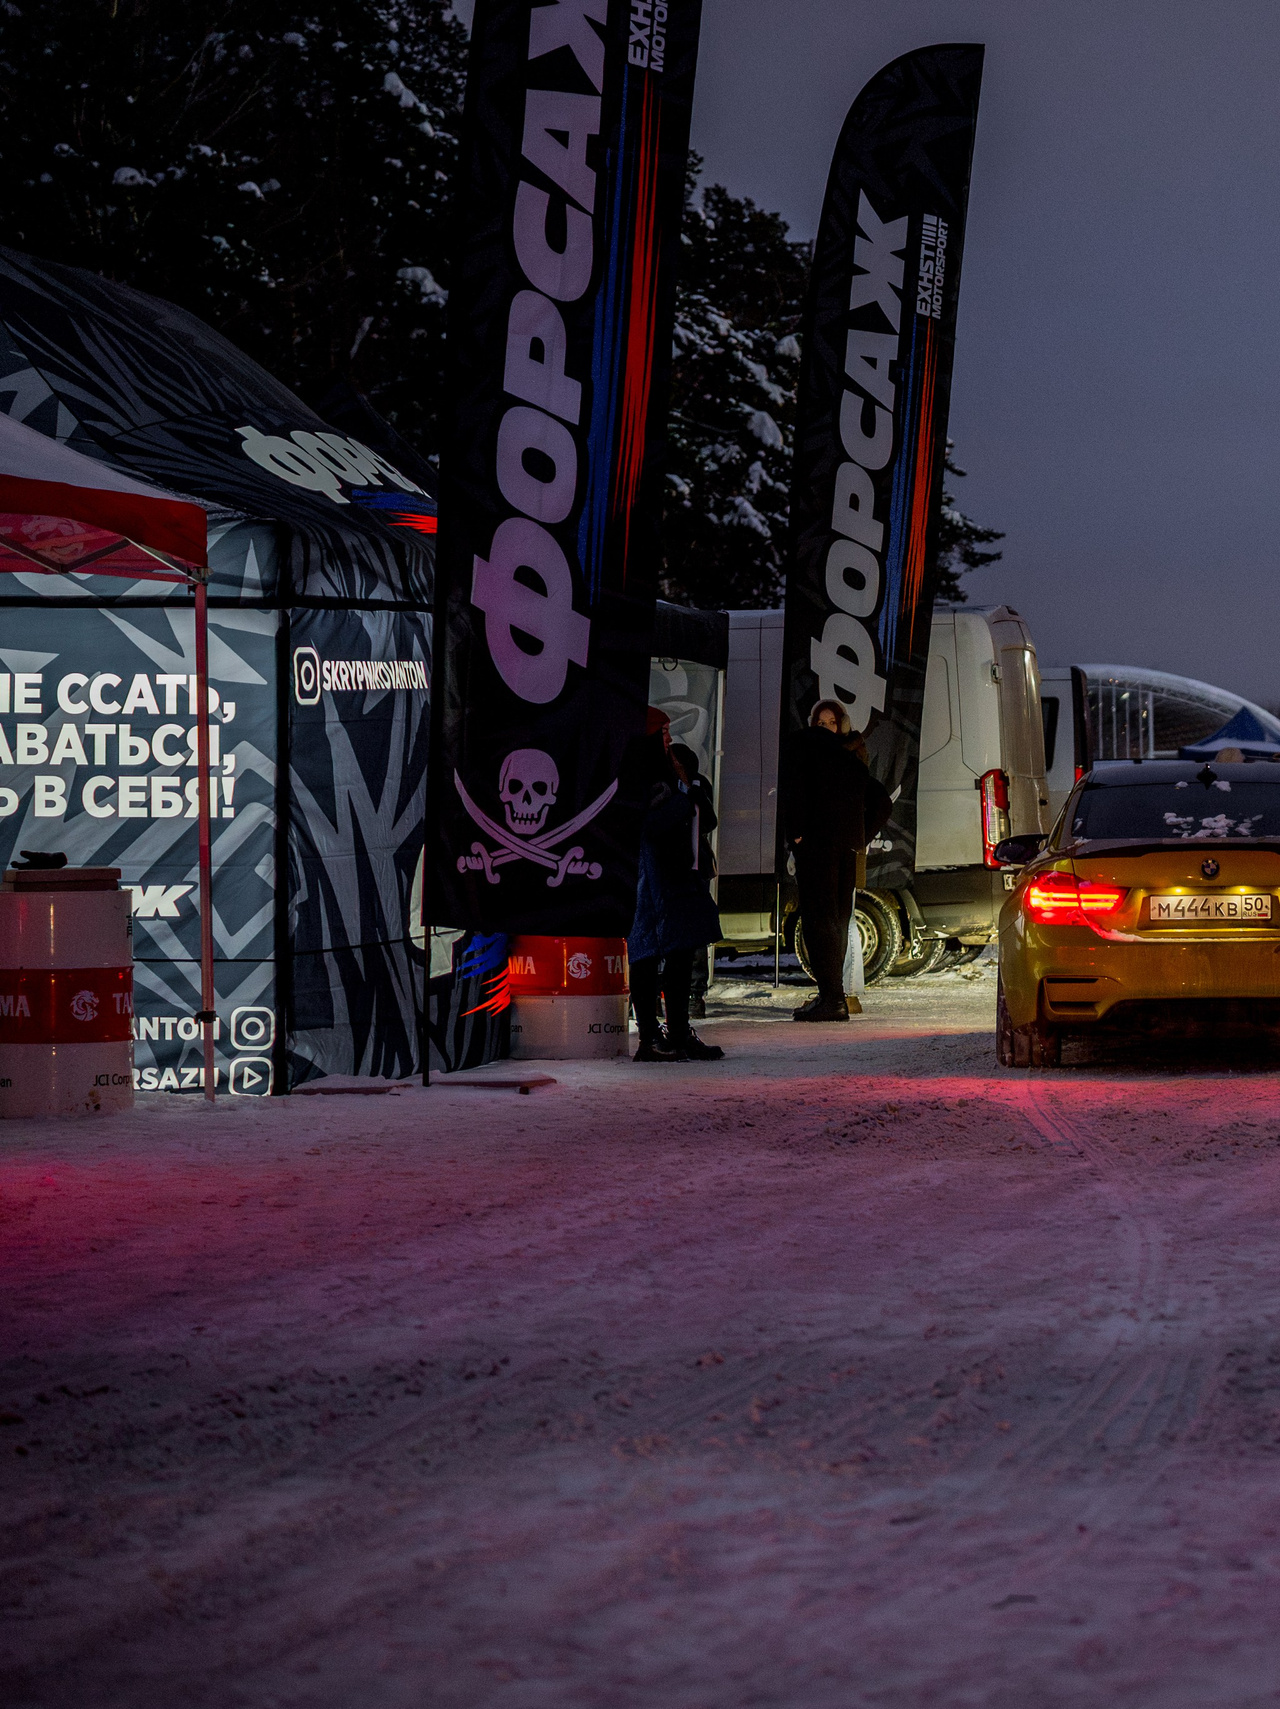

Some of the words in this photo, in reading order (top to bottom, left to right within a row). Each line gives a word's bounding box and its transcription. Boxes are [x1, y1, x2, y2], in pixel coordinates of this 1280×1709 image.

[628, 0, 653, 68] EXH
[931, 217, 949, 320] MOTORSPORT
[234, 425, 433, 504] ФОРС
[810, 187, 909, 735] ФОРСАЖ
[57, 673, 237, 724] ССАТЬ,
[34, 776, 67, 817] В
[82, 776, 236, 818] СЕБЯ!
[1158, 898, 1238, 918] М444КВ
[1244, 897, 1263, 911] 50
[588, 1023, 602, 1034] JCI
[93, 1074, 110, 1087] JCI
